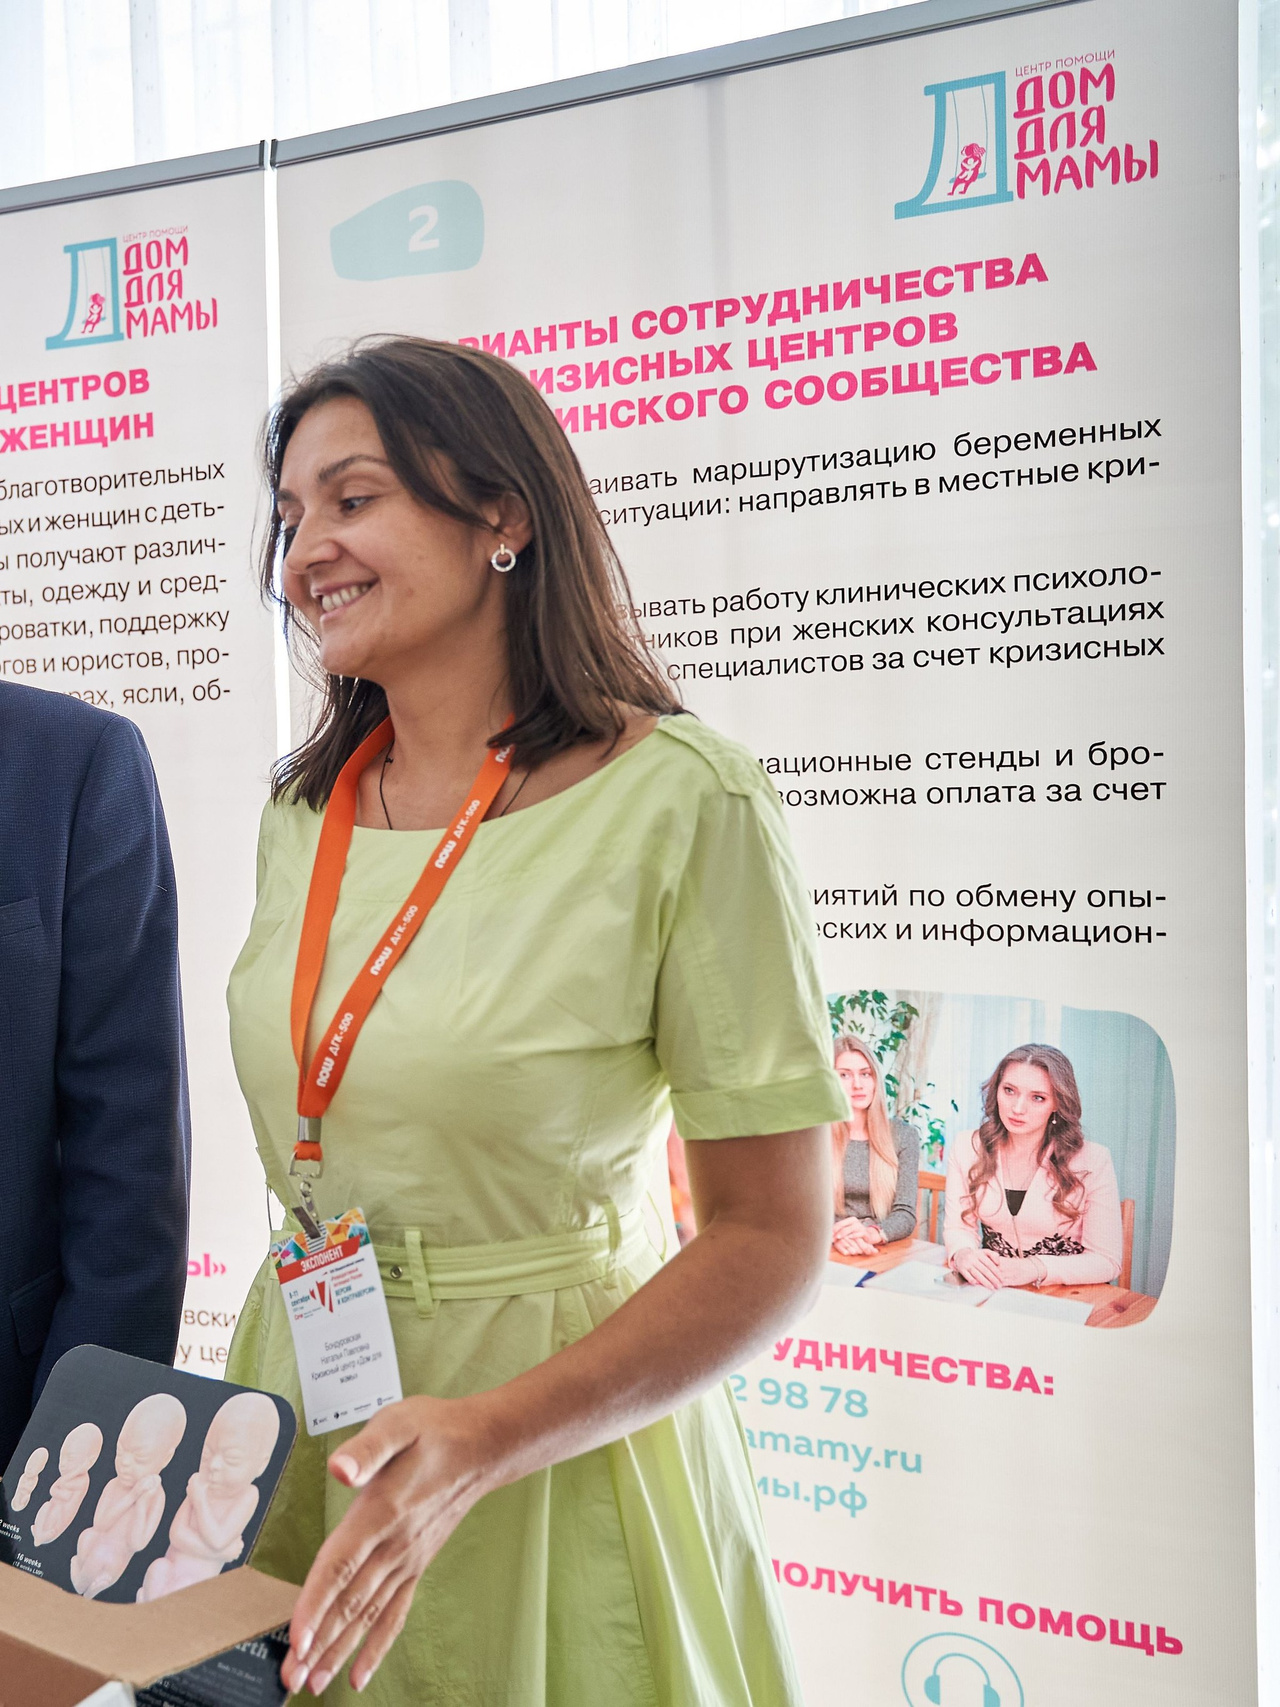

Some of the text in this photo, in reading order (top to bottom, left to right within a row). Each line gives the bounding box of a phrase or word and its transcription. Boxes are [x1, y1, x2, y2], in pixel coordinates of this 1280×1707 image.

[1015, 49, 1115, 77] ЦЕНТР ПОМОЩИ
[1013, 63, 1115, 119] ДОМ
[1014, 105, 1106, 160] ДЛЯ
[1017, 139, 1159, 199] МАМЫ
[122, 225, 188, 243] ЦЕНТР ПОМОЩИ
[407, 207, 440, 252] 2
[122, 236, 188, 276] ДОМ
[124, 268, 183, 308] ДЛЯ
[631, 252, 1049, 340] СОТРУДНИЧЕСТВА
[126, 297, 218, 340] МАМЫ
[748, 311, 959, 371] ЦЕНТРОВ
[764, 341, 1098, 410] СООБЩЕСТВА
[693, 441, 936, 485] маршрутизацию
[953, 418, 1162, 458] беременных
[599, 456, 1160, 527] ситуации: направлять в местные кри-
[28, 516, 41, 533] и
[45, 504, 140, 532] женщин
[145, 504, 157, 523] с
[161, 500, 225, 525] деть-
[17, 545, 126, 571] получают
[134, 537, 226, 565] различ-
[42, 580, 130, 603] одежду
[139, 578, 152, 595] и
[160, 573, 227, 597] сред-
[712, 586, 809, 618] работу
[816, 575, 1007, 606] клинических
[1014, 565, 1162, 593] психоло-
[100, 609, 230, 636] поддержку
[730, 624, 781, 649] при
[792, 616, 915, 642] женских
[927, 600, 1165, 634] консультациях
[42, 658, 56, 673] и
[61, 651, 170, 676] юристов,
[177, 647, 229, 670] про-
[667, 637, 1165, 681] специалистов за счет кризисных
[123, 679, 231, 706] ясли, об-
[759, 740, 1164, 777] ационные стенды и бро-
[926, 782, 1036, 804] оплата
[1045, 781, 1082, 802] за
[1092, 780, 1167, 802] счет
[807, 883, 1166, 913] иятий по обмену опы-
[896, 922, 912, 940] и
[922, 918, 1167, 947] информацион-
[300, 1245, 344, 1273] ЭКСПОНЕНТ
[758, 1377, 809, 1410] 98
[820, 1386, 869, 1418] 78
[3, 1521, 20, 1533] weeks
[24, 1556, 42, 1568] weeks
[978, 1596, 1184, 1657] ПОМОЩЬ
